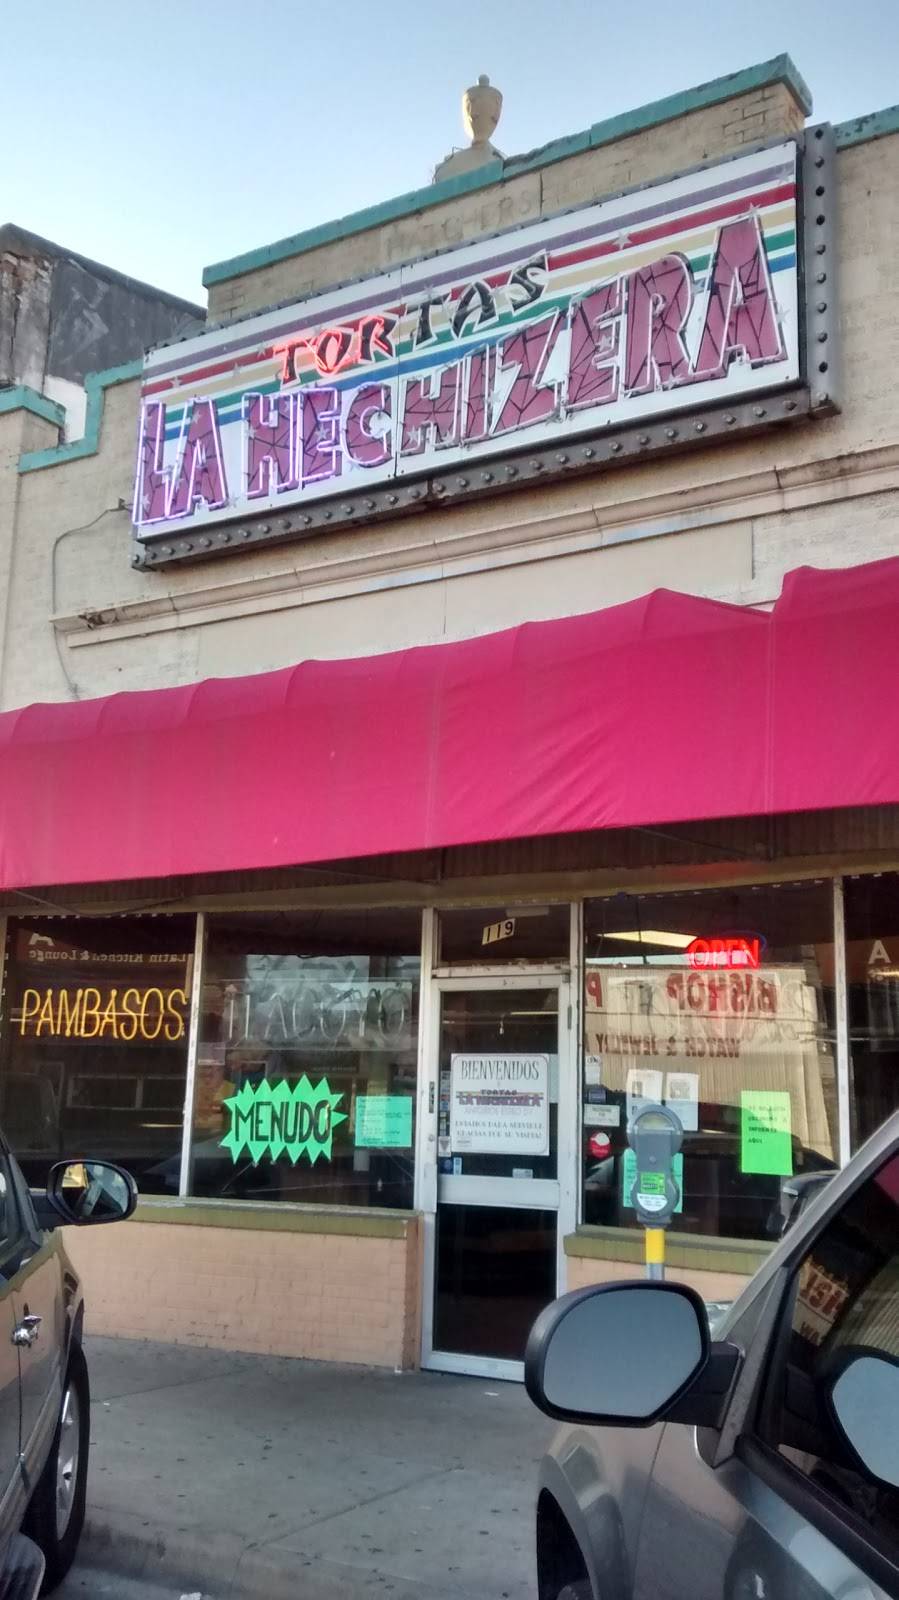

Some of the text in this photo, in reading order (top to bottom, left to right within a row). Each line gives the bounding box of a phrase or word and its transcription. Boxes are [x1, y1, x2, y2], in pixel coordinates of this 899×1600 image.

[273, 249, 549, 389] TORTAS
[131, 209, 788, 525] LA HECHIZERA
[485, 920, 514, 945] 119
[686, 937, 760, 970] OPEN
[20, 987, 188, 1040] PAMBASOS
[461, 1060, 539, 1080] BIENVENIDOS
[234, 1100, 331, 1144] MENUDO
